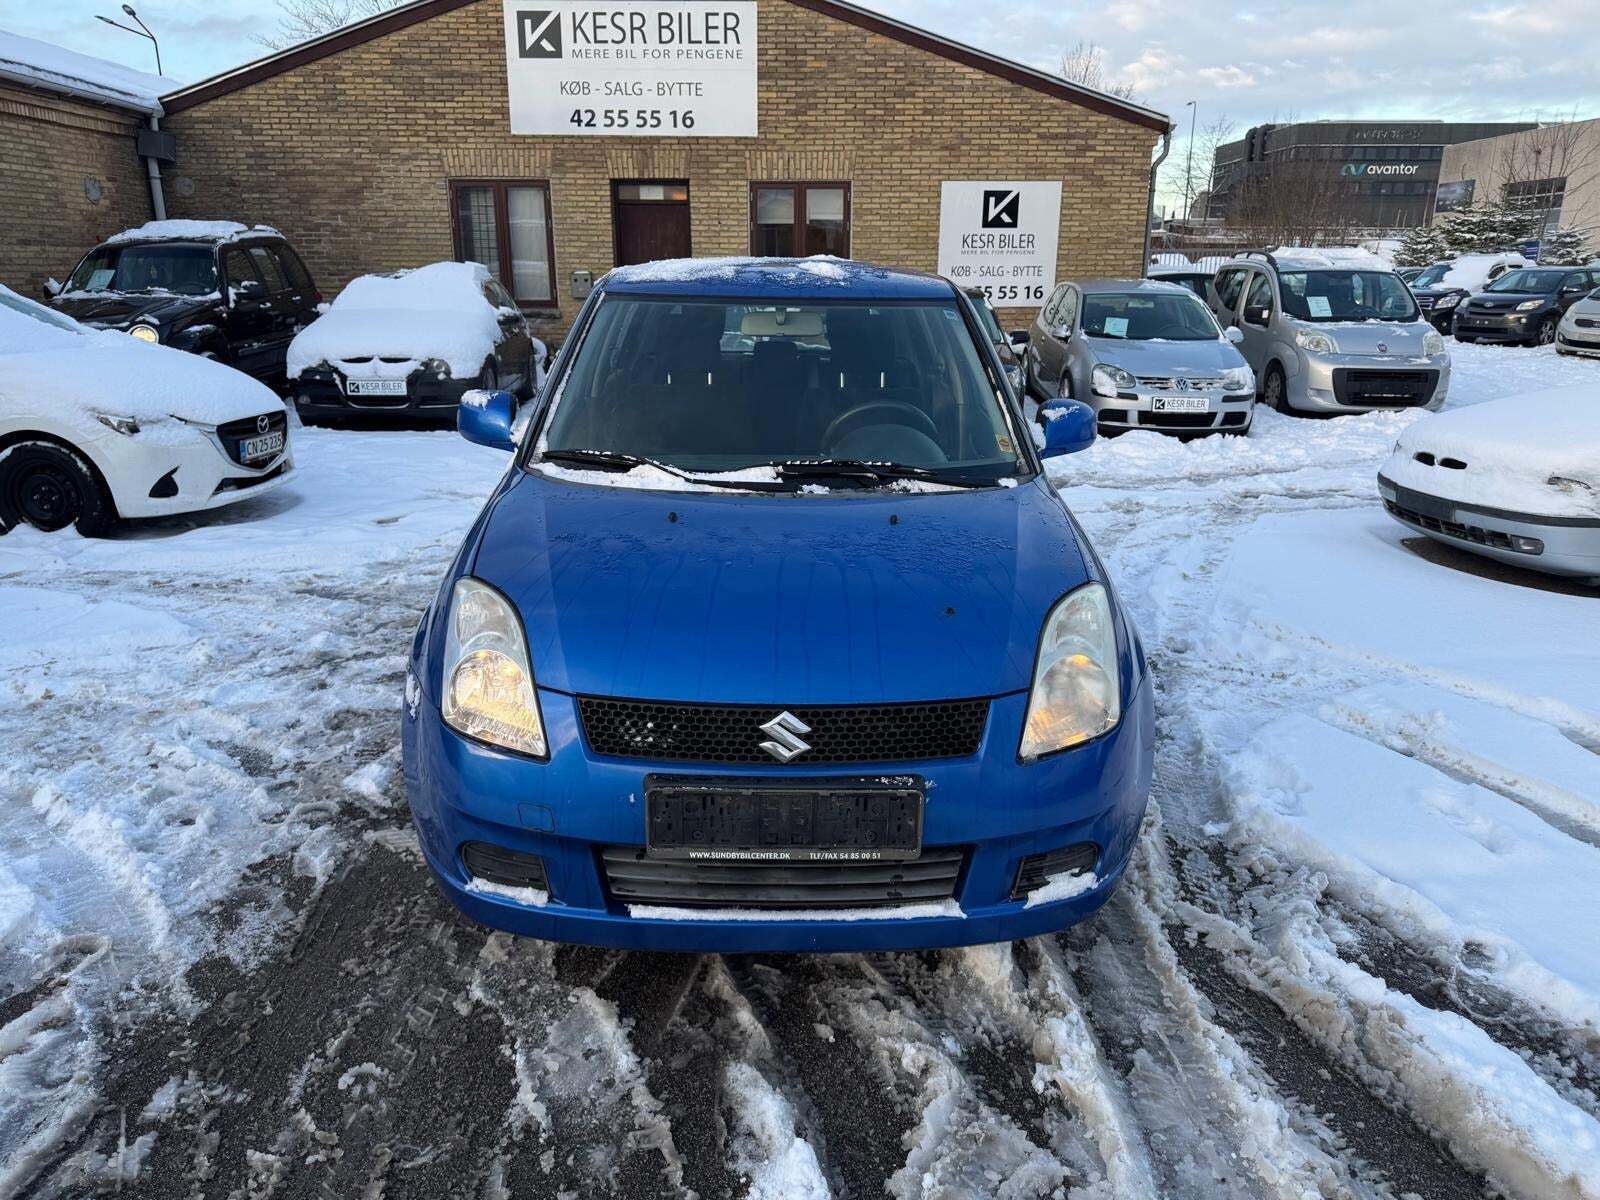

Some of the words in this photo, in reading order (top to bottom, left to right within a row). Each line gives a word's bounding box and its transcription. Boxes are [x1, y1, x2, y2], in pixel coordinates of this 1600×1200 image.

[572, 11, 647, 45] KESR
[657, 11, 741, 45] BILER
[571, 48, 610, 60] MERE
[616, 48, 637, 60] BIL
[643, 48, 671, 60] FOR
[677, 48, 744, 60] PENGENE
[560, 80, 591, 96] KØB
[604, 81, 643, 96] SALG
[656, 82, 704, 97] BYTTE
[569, 108, 597, 128] 42
[603, 108, 629, 128] 55
[635, 109, 662, 129] 55
[668, 109, 695, 129] 16
[1367, 163, 1419, 175] avantor
[962, 233, 995, 249] KESR
[998, 233, 1035, 249] BILER
[950, 265, 971, 278] KØB
[979, 265, 1005, 278] SALG
[1012, 265, 1043, 278] BYTTE
[974, 285, 993, 300] 5
[998, 285, 1018, 299] 55
[1024, 285, 1044, 299] 16
[361, 382, 380, 391] KESR
[381, 382, 404, 391] BILER
[1166, 399, 1185, 408] KESR
[1186, 399, 1206, 408] BILER
[247, 440, 258, 456] CN
[259, 438, 269, 453] 25
[689, 851, 791, 860] WWW.SUNDBYBILCENTER.DK
[809, 852, 838, 860] TLF/FAX
[839, 852, 848, 860] 54
[850, 852, 860, 860] 85
[861, 852, 871, 860] 00
[872, 852, 881, 860] 51
